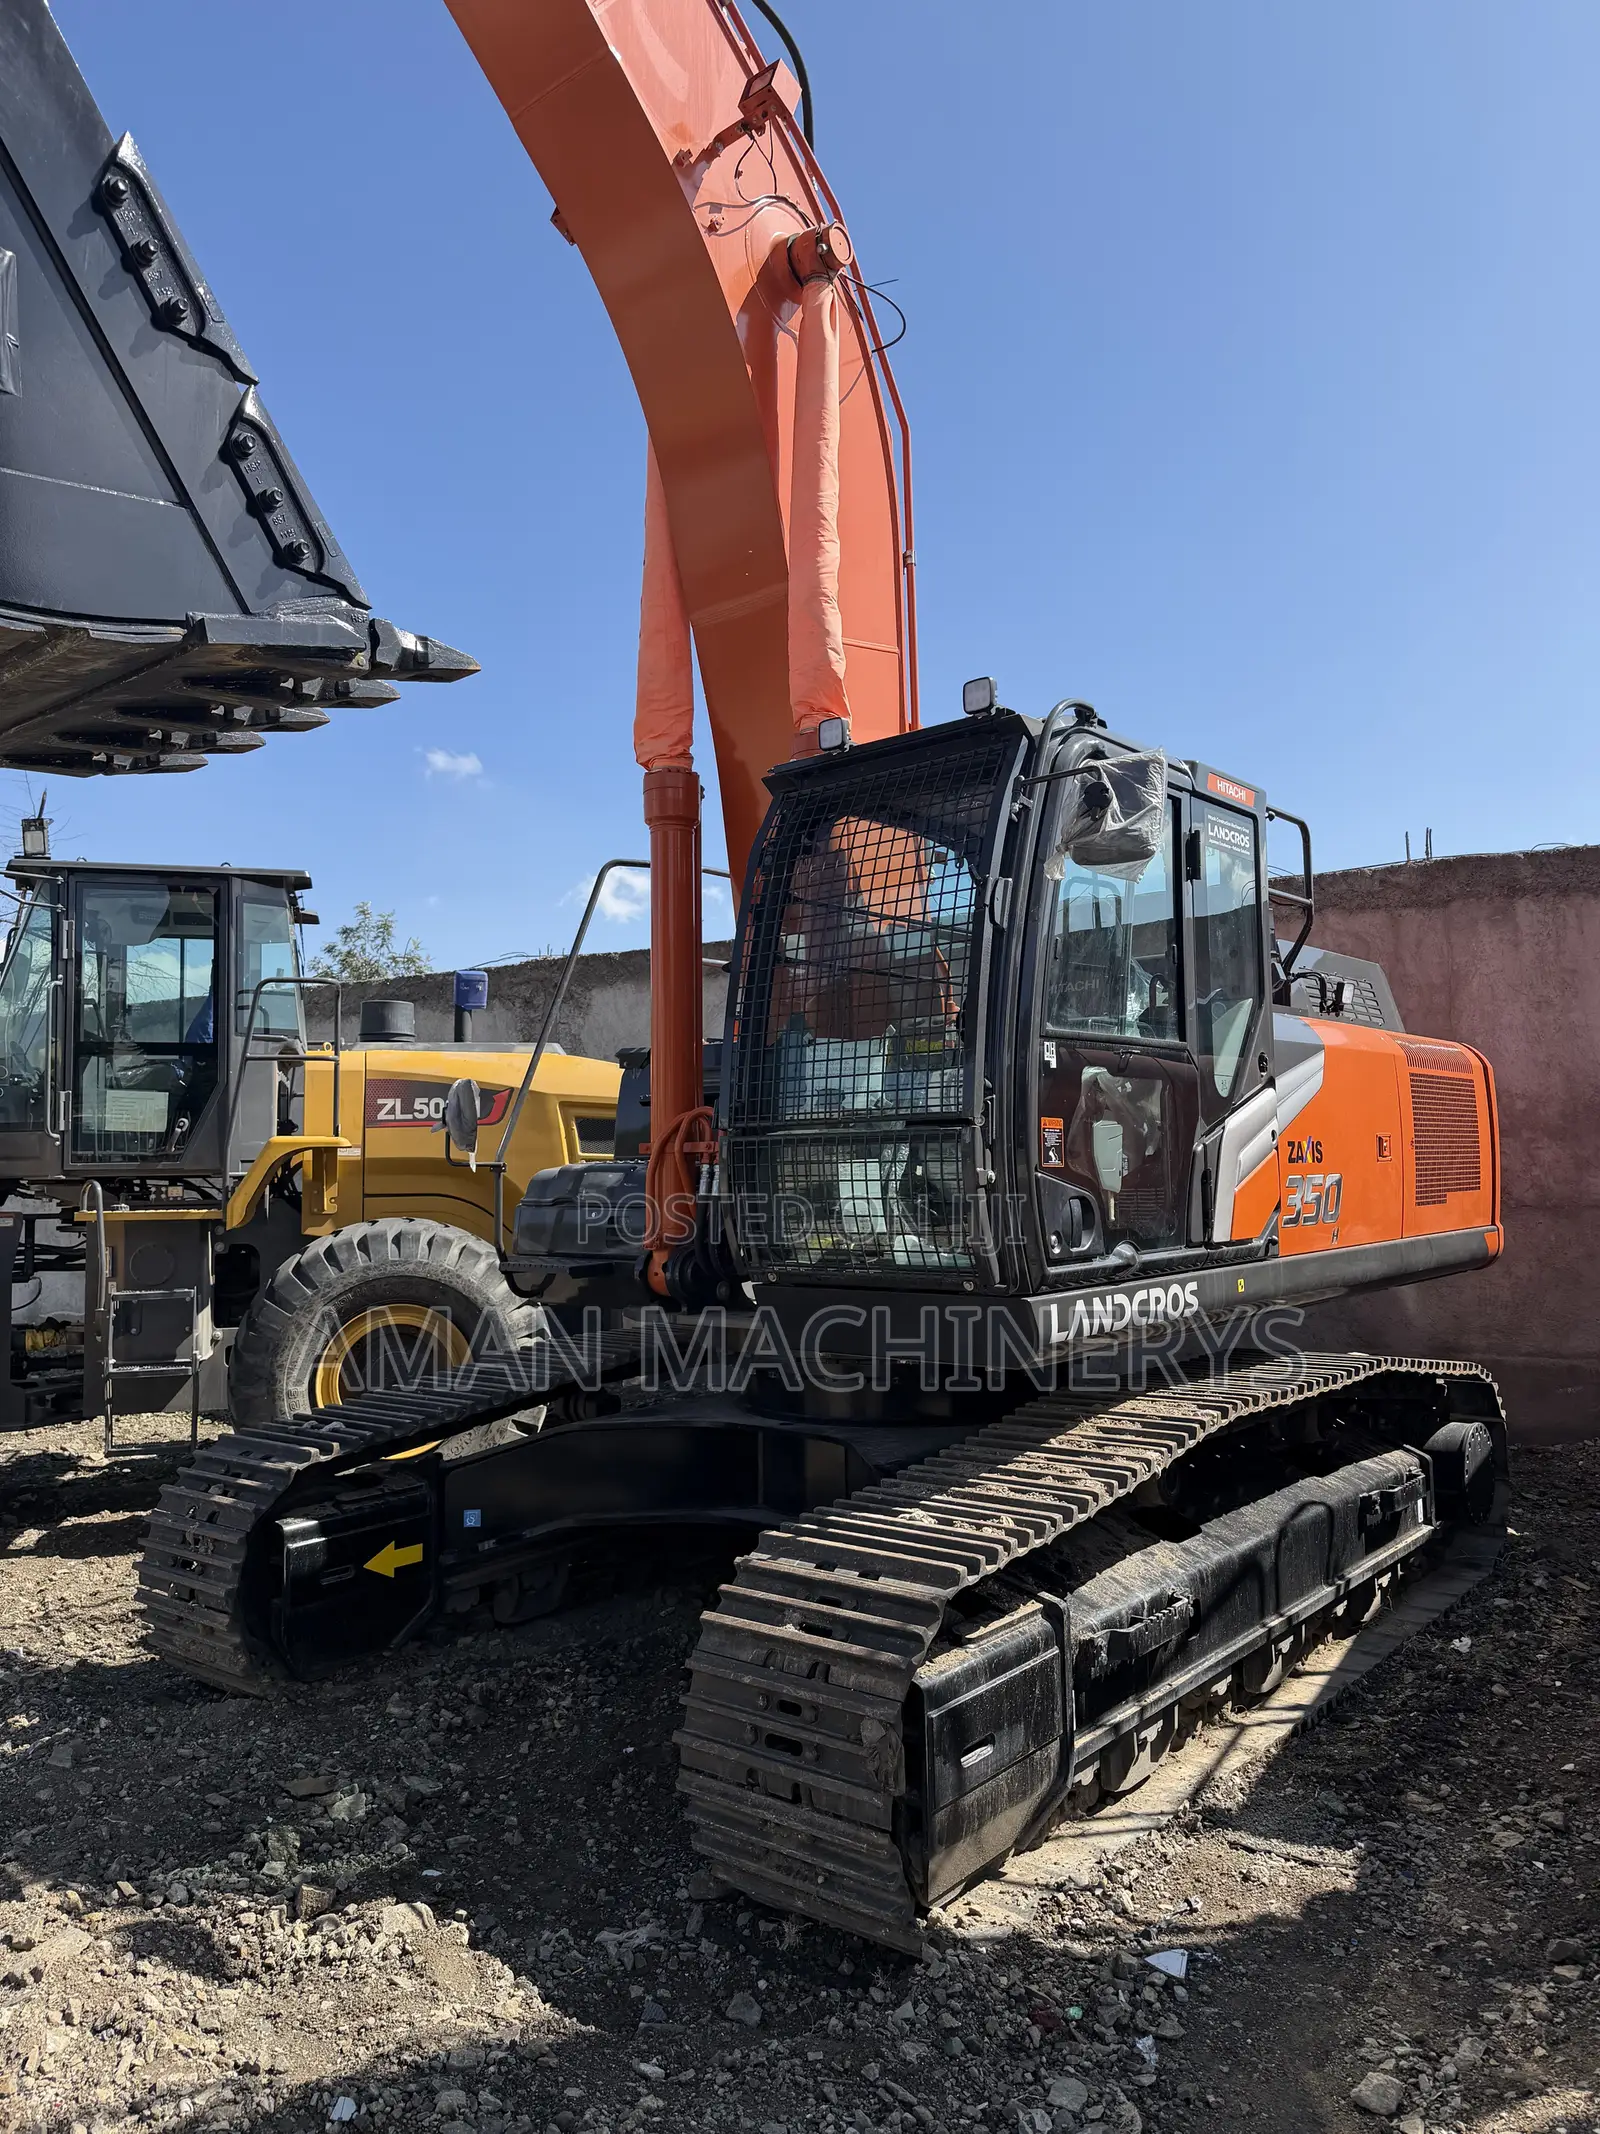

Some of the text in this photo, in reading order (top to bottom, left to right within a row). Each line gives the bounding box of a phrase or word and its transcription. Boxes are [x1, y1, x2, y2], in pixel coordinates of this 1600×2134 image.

[1217, 779, 1246, 801] HITACHI
[1208, 822, 1250, 848] LANDCROS
[1287, 1135, 1323, 1164] ZAXIS
[1281, 1173, 1343, 1228] 350
[1331, 1226, 1339, 1245] H
[1049, 1281, 1200, 1344] LANDCROS
